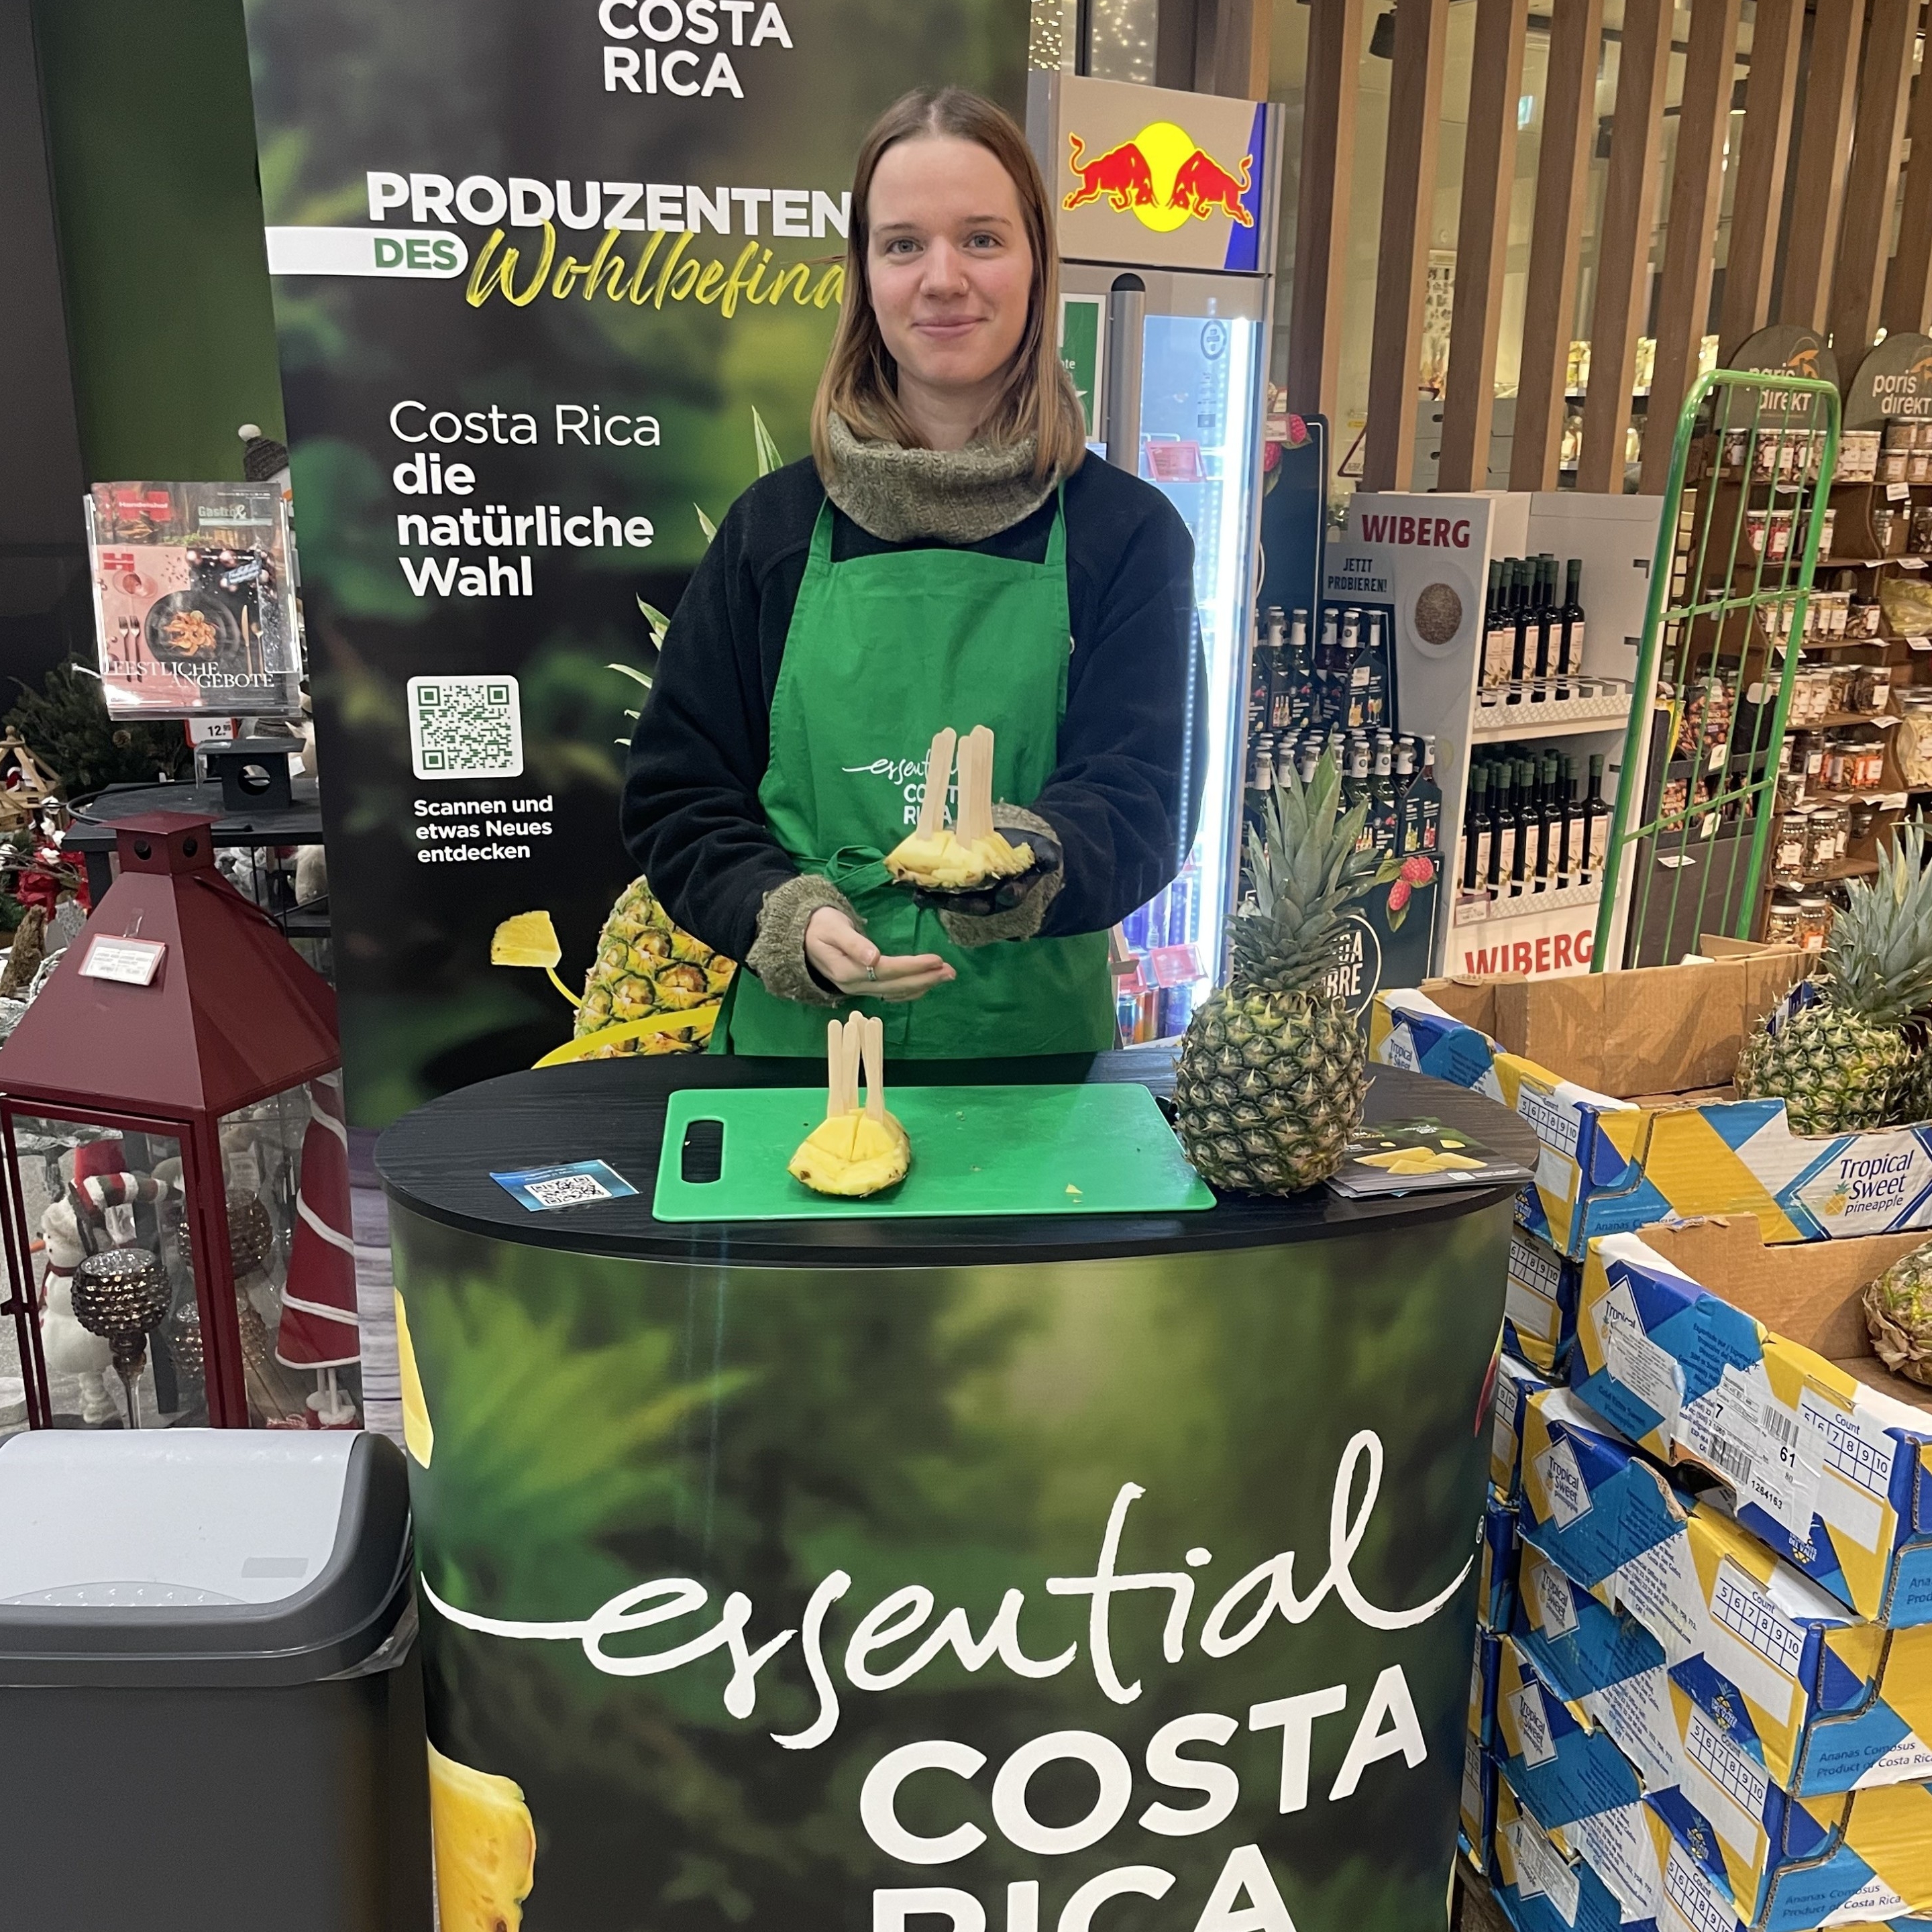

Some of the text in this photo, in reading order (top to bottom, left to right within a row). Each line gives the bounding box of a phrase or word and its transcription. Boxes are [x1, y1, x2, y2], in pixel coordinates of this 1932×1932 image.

[598, 0, 794, 48] COSTA
[604, 46, 745, 99] RICA
[366, 171, 852, 238] PRODUZENTEN
[374, 237, 458, 271] DES
[1872, 369, 1917, 397] paris
[390, 400, 660, 446] Costa Rica
[392, 452, 476, 496] die
[396, 505, 655, 547] natürliche
[1361, 514, 1470, 548] WIBERG
[398, 555, 533, 597] Wahl
[1343, 558, 1373, 573] JETZT
[1328, 576, 1387, 593] PROBIEREN!
[113, 661, 219, 676] FESTLICHE
[171, 674, 274, 688] ANGEBOTE
[414, 795, 553, 816] Scannen und
[415, 820, 553, 840] etwas Neues
[417, 843, 531, 863] entdecken
[1465, 930, 1593, 975] WIBERG
[1522, 1102, 1576, 1138] 5 6 7 8 9 10
[1841, 1150, 1915, 1179] Tropical
[1849, 1174, 1907, 1199] Sweet
[1845, 1195, 1903, 1216] pineapple
[1595, 1222, 1628, 1232] Ananas
[1511, 1246, 1558, 1281] 6 7 8 9 10
[1716, 1403, 1723, 1419] 7
[1835, 1413, 1860, 1435] Count
[1780, 1446, 1795, 1468] 61
[1833, 1431, 1839, 1442] 7
[1847, 1440, 1854, 1452] 8
[1862, 1450, 1869, 1461] 9
[1877, 1458, 1888, 1473] 10
[1549, 1455, 1579, 1491] Tropical
[1555, 1475, 1578, 1505] Sweet
[420, 1429, 1474, 1750] essential
[1752, 1591, 1775, 1614] Count
[1721, 1587, 1799, 1654] 5 6 7 8 9 10
[1721, 1733, 1741, 1758] Count
[1819, 1741, 1916, 1763] Ananas Comosus
[859, 1662, 1430, 1866] COSTA
[1694, 1725, 1763, 1799] 5 6 7 8 9 10
[1817, 1764, 1860, 1778] Product
[1878, 1757, 1910, 1768] Costa
[1668, 1862, 1674, 1872] 5
[1678, 1874, 1684, 1885] 6
[1688, 1886, 1695, 1896] 7
[1699, 1900, 1705, 1911] 8
[1710, 1913, 1716, 1924] 9
[1693, 1872, 1711, 1898] Count
[1785, 1884, 1880, 1905] Ananas Comosus
[1782, 1905, 1827, 1917] Product
[1844, 1898, 1875, 1909] Costa
[1878, 1895, 1901, 1906] Rica
